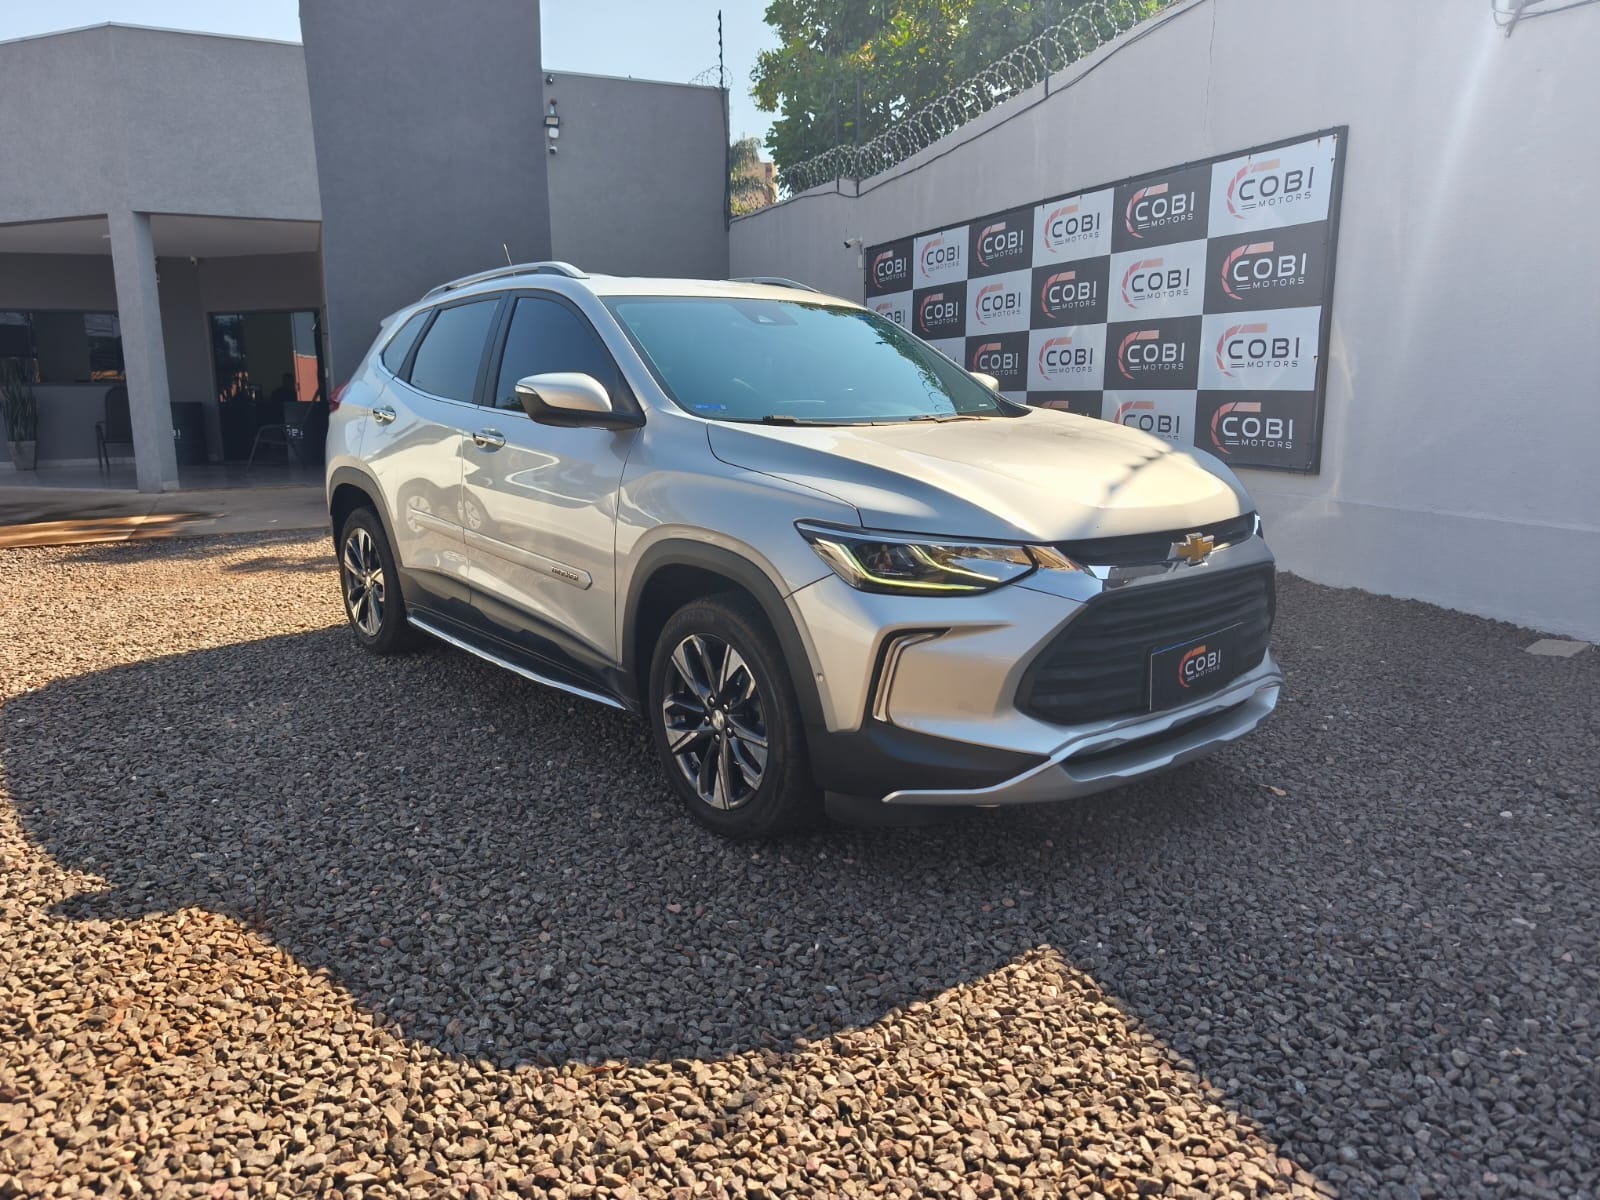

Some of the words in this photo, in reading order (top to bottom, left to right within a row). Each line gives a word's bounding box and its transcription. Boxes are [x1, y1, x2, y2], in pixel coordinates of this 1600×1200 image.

[1239, 166, 1315, 200] COBI
[1135, 191, 1195, 221] COBI
[1259, 191, 1312, 207] MOTORS
[1052, 212, 1100, 238] COBI
[1151, 213, 1193, 227] MOTORS
[983, 230, 1024, 253] COBI
[1065, 232, 1100, 243] MOTORS
[926, 245, 960, 265] COBI
[995, 247, 1023, 257] MOTORS
[877, 257, 907, 276] COBI
[1234, 252, 1307, 281] COBI
[1131, 268, 1190, 292] COBI
[1252, 276, 1305, 289] MOTORS
[1049, 280, 1097, 303] COBI
[1147, 288, 1189, 299] MOTORS
[925, 302, 958, 319] COBI
[982, 292, 1021, 311] COBI
[1062, 300, 1097, 309] MOTORS
[881, 310, 906, 324] OBI
[1046, 347, 1093, 366] COBI
[1127, 342, 1185, 363] COBI
[1228, 337, 1300, 359] COBI
[979, 352, 1019, 370] COBI
[1143, 362, 1184, 370] MOTORS
[1247, 360, 1298, 368] MOTORS
[1222, 417, 1293, 440] COBI
[1241, 439, 1292, 449] MOTORS
[1185, 648, 1221, 675] COBI
